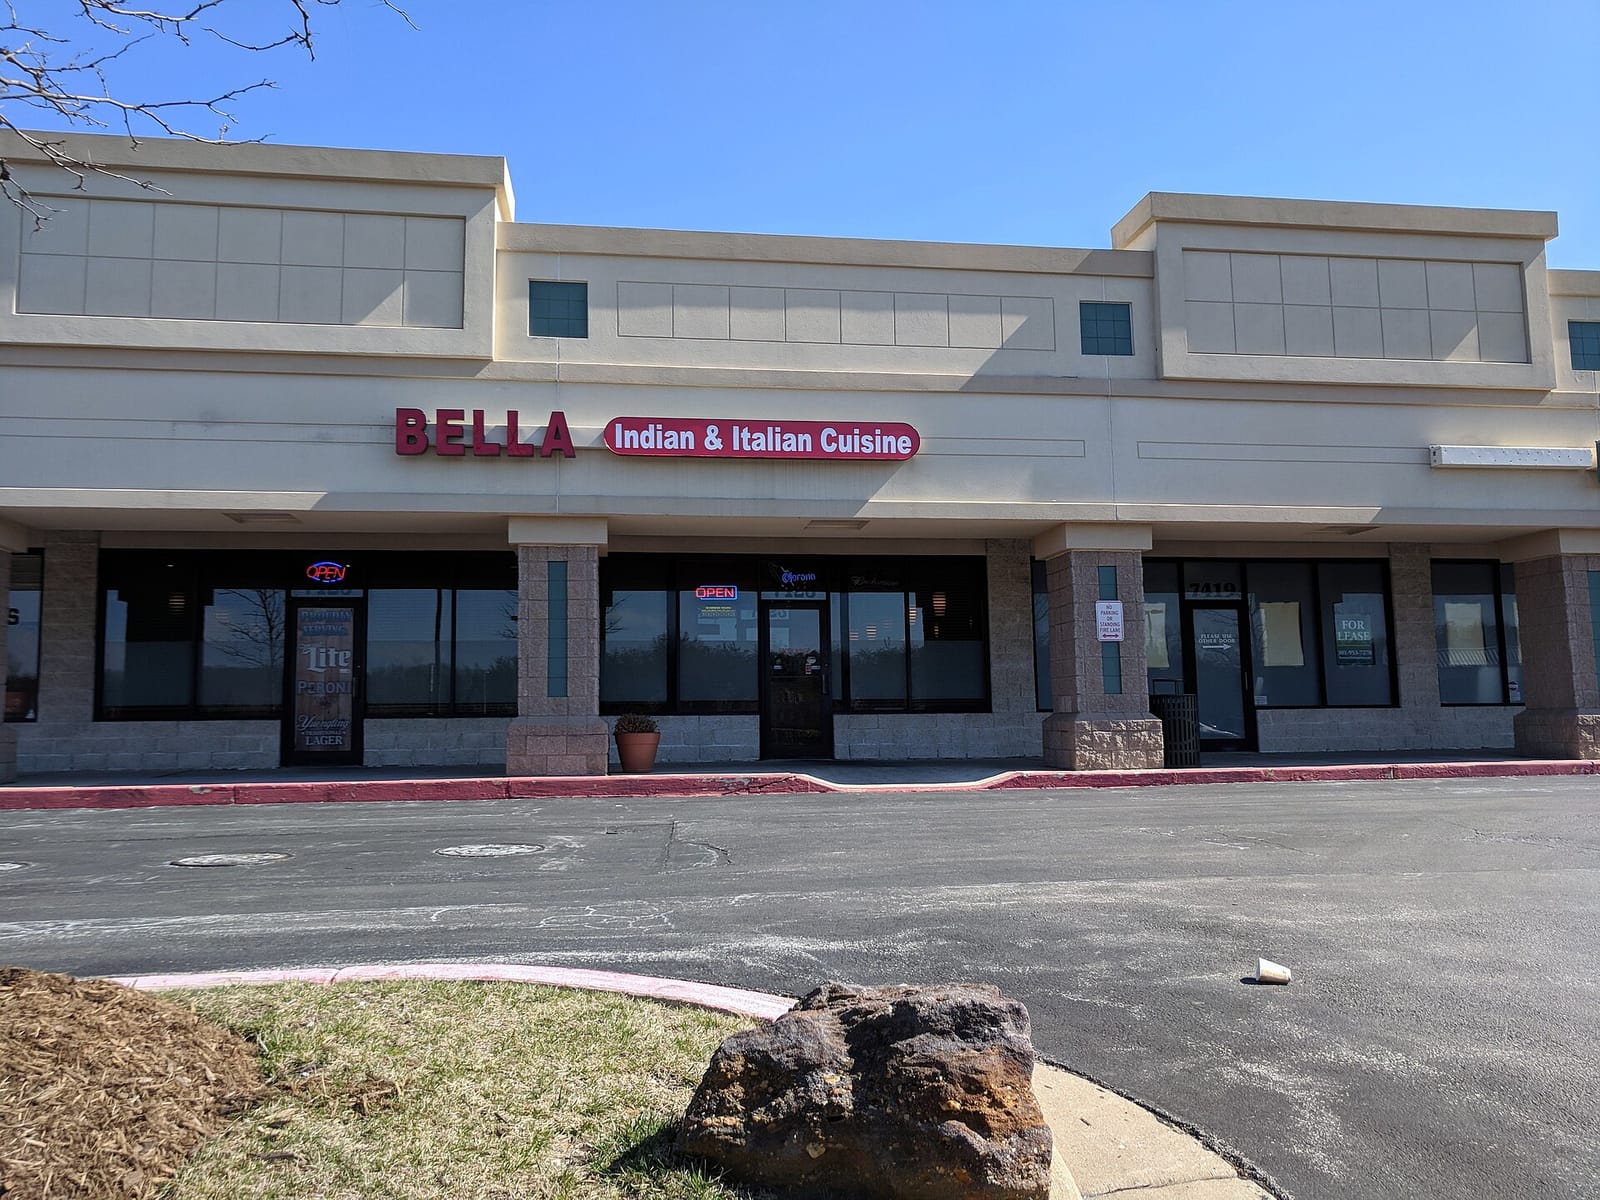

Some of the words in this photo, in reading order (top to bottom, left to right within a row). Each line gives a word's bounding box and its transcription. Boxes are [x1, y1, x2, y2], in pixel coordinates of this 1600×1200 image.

[395, 407, 577, 459] BELLA
[614, 423, 695, 450] Indian
[703, 424, 724, 451] &
[732, 425, 812, 452] Italian
[820, 427, 912, 455] Cuisine
[305, 565, 346, 580] OPEN
[781, 571, 817, 584] Corona
[695, 587, 735, 598] OPEN
[1189, 582, 1236, 597] 7419
[1342, 620, 1365, 630] FOR
[1337, 632, 1371, 640] LEASE
[300, 646, 351, 673] Lite
[297, 680, 351, 695] PERONI
[305, 735, 343, 746] LAGER
